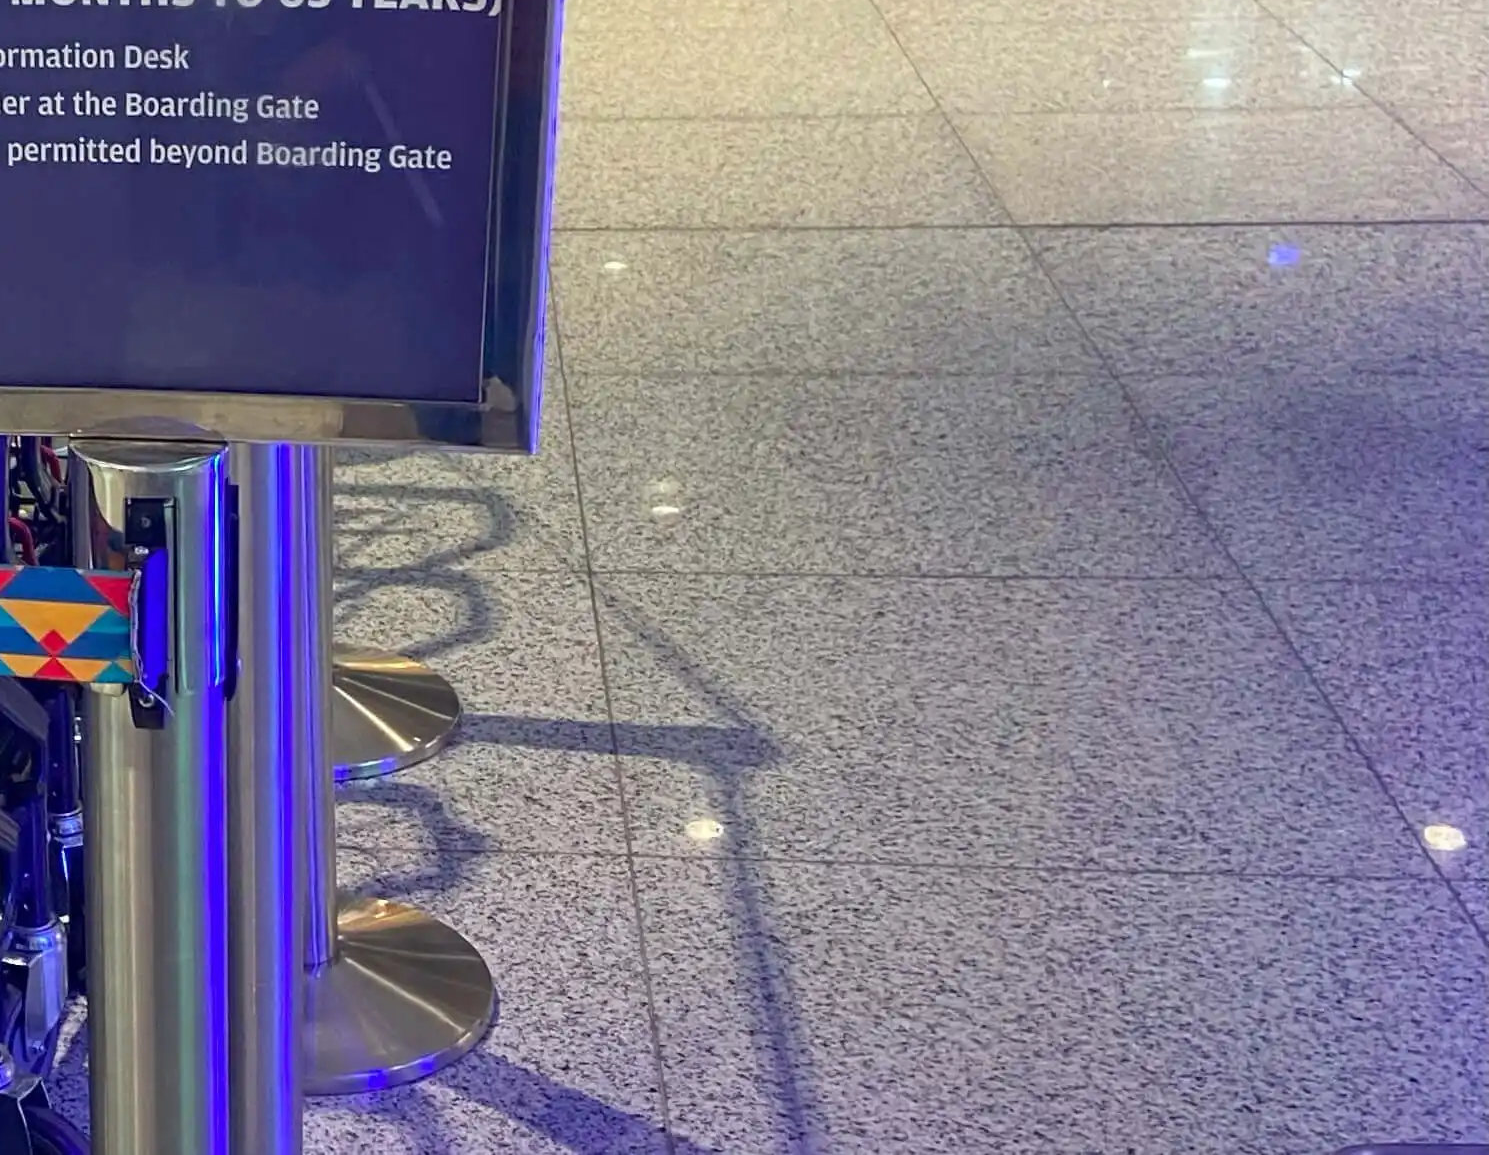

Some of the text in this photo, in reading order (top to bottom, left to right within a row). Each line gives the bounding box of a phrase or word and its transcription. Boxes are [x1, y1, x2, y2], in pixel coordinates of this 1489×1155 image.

[124, 43, 190, 70] Desk
[37, 93, 65, 117] at
[73, 90, 117, 117] the
[124, 91, 249, 123] Boarding
[256, 94, 320, 119] Gate
[7, 136, 141, 167] permitted
[149, 138, 247, 169] beyond
[256, 141, 381, 173] Boarding
[388, 144, 452, 170] Gate
